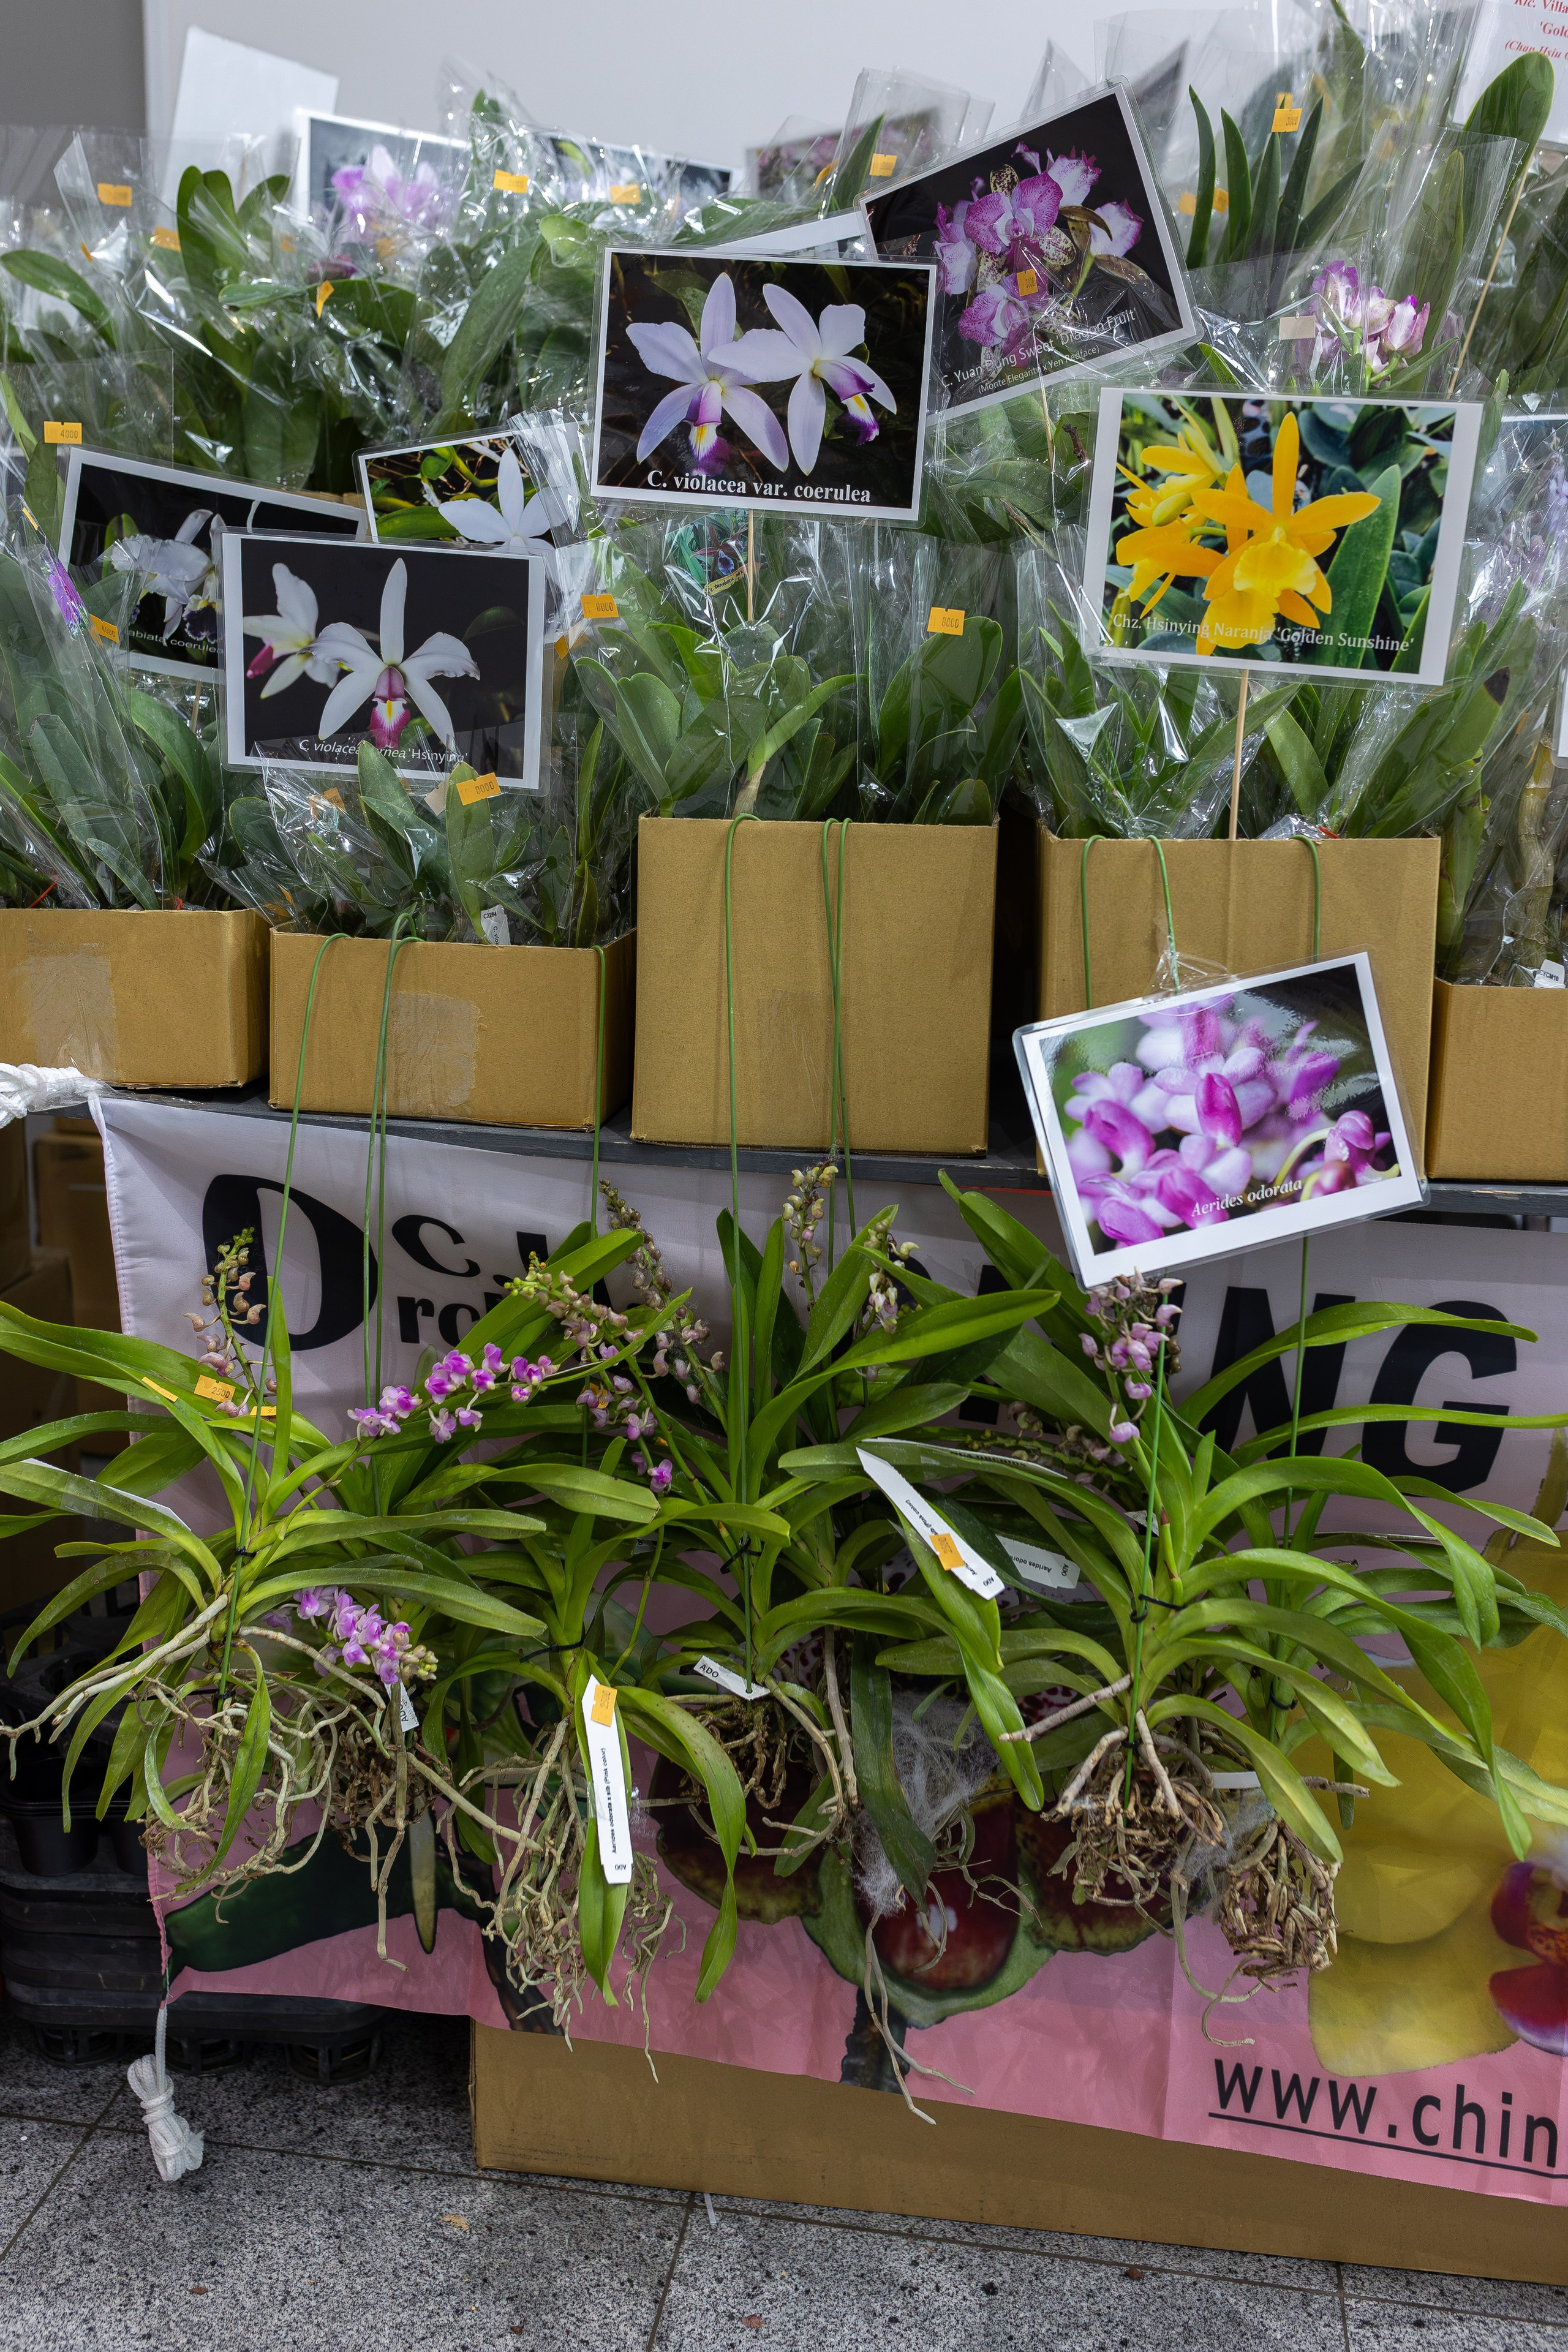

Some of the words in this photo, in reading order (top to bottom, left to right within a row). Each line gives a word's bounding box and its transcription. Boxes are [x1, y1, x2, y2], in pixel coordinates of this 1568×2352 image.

[953, 365, 984, 383] Yuan
[1019, 338, 1055, 360] Sweet
[978, 378, 1008, 395] (Monte
[1048, 358, 1064, 369] Yen
[1066, 344, 1100, 364] Redface)
[60, 429, 78, 439] 4000
[647, 469, 667, 488] C.
[673, 472, 747, 494] violacea
[752, 481, 788, 497] var.
[794, 484, 871, 503] coerulea
[1112, 614, 1142, 630] Chz.
[1146, 619, 1210, 639] Hsinying
[1213, 622, 1272, 641] Naranja
[1277, 626, 1334, 646] 'Golden
[1338, 633, 1414, 653] Sunshine'
[170, 639, 224, 654] coerulea
[299, 739, 309, 752] C.
[1191, 1193, 1243, 1218] Aerides
[1246, 1179, 1303, 1202] odorata
[211, 1386, 230, 1399] 2500
[1028, 1559, 1052, 1574] Aerides
[1061, 1563, 1069, 1577] ADO
[699, 1664, 719, 1678] ADO
[1214, 2057, 1559, 2169] www.chin
